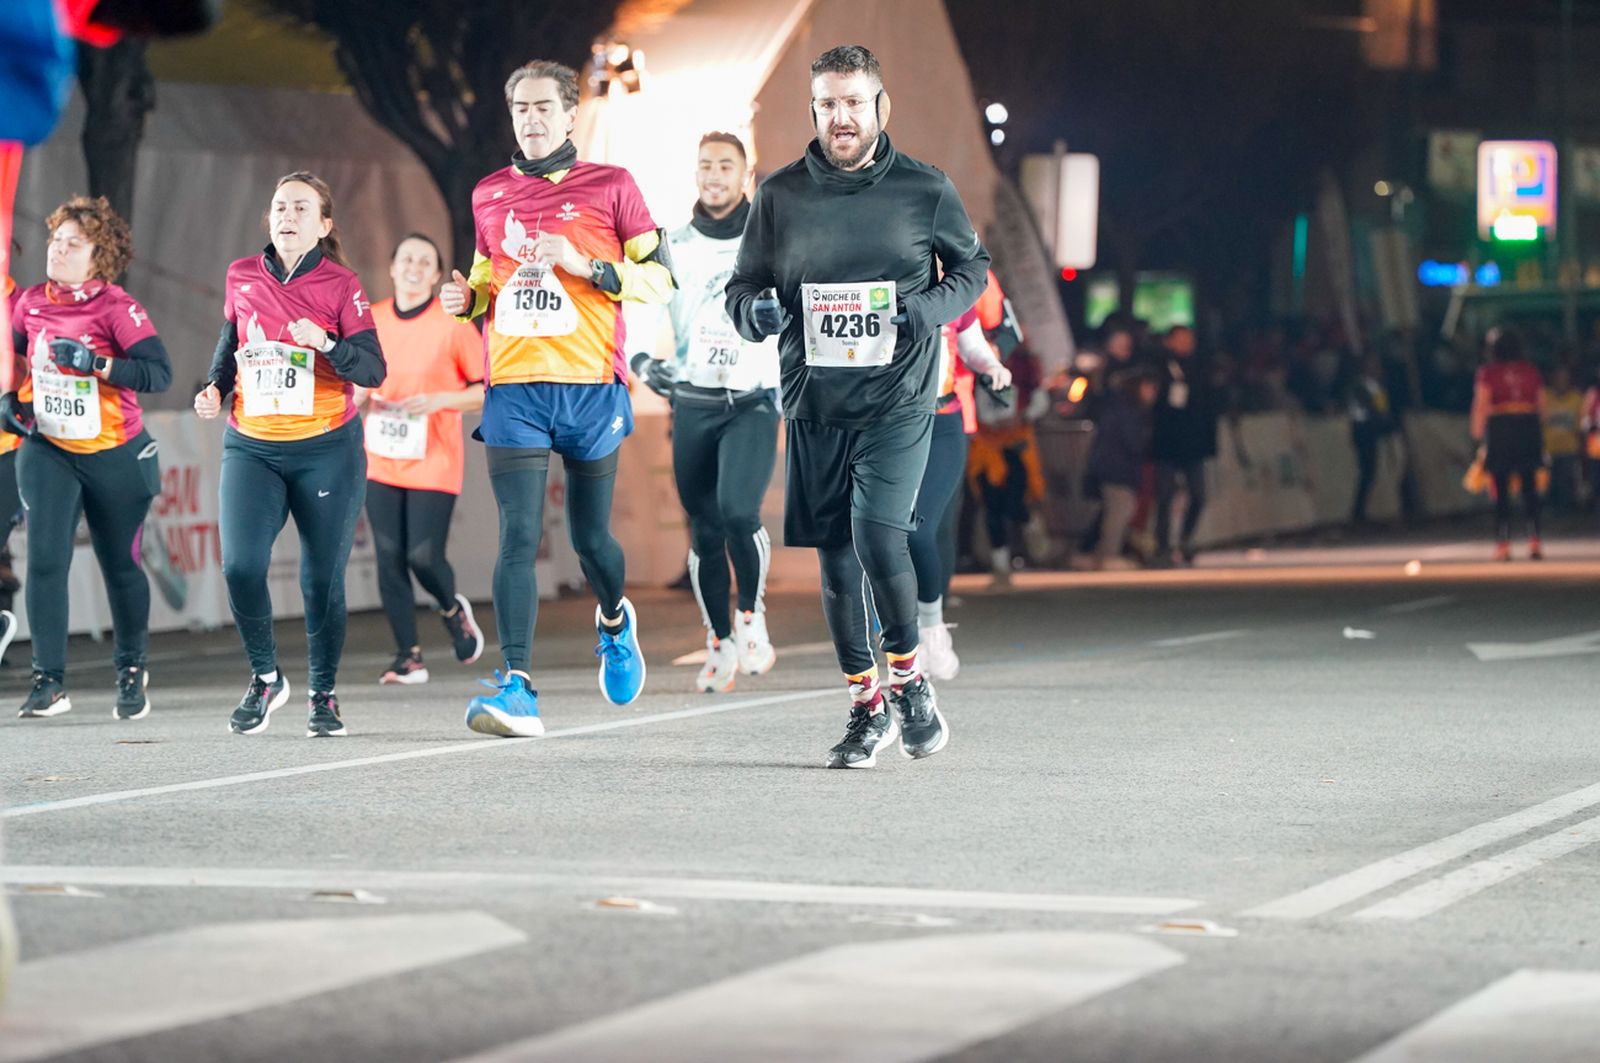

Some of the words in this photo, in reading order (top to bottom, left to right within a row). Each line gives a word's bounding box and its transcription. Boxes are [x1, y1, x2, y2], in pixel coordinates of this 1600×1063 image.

[513, 289, 562, 311] 1305
[812, 304, 830, 312] SAN
[832, 301, 862, 312] ANTÓN
[822, 293, 848, 301] NOCHE
[850, 292, 861, 300] DE
[820, 313, 881, 338] 4236
[255, 367, 297, 390] 1848
[44, 395, 86, 417] 6396
